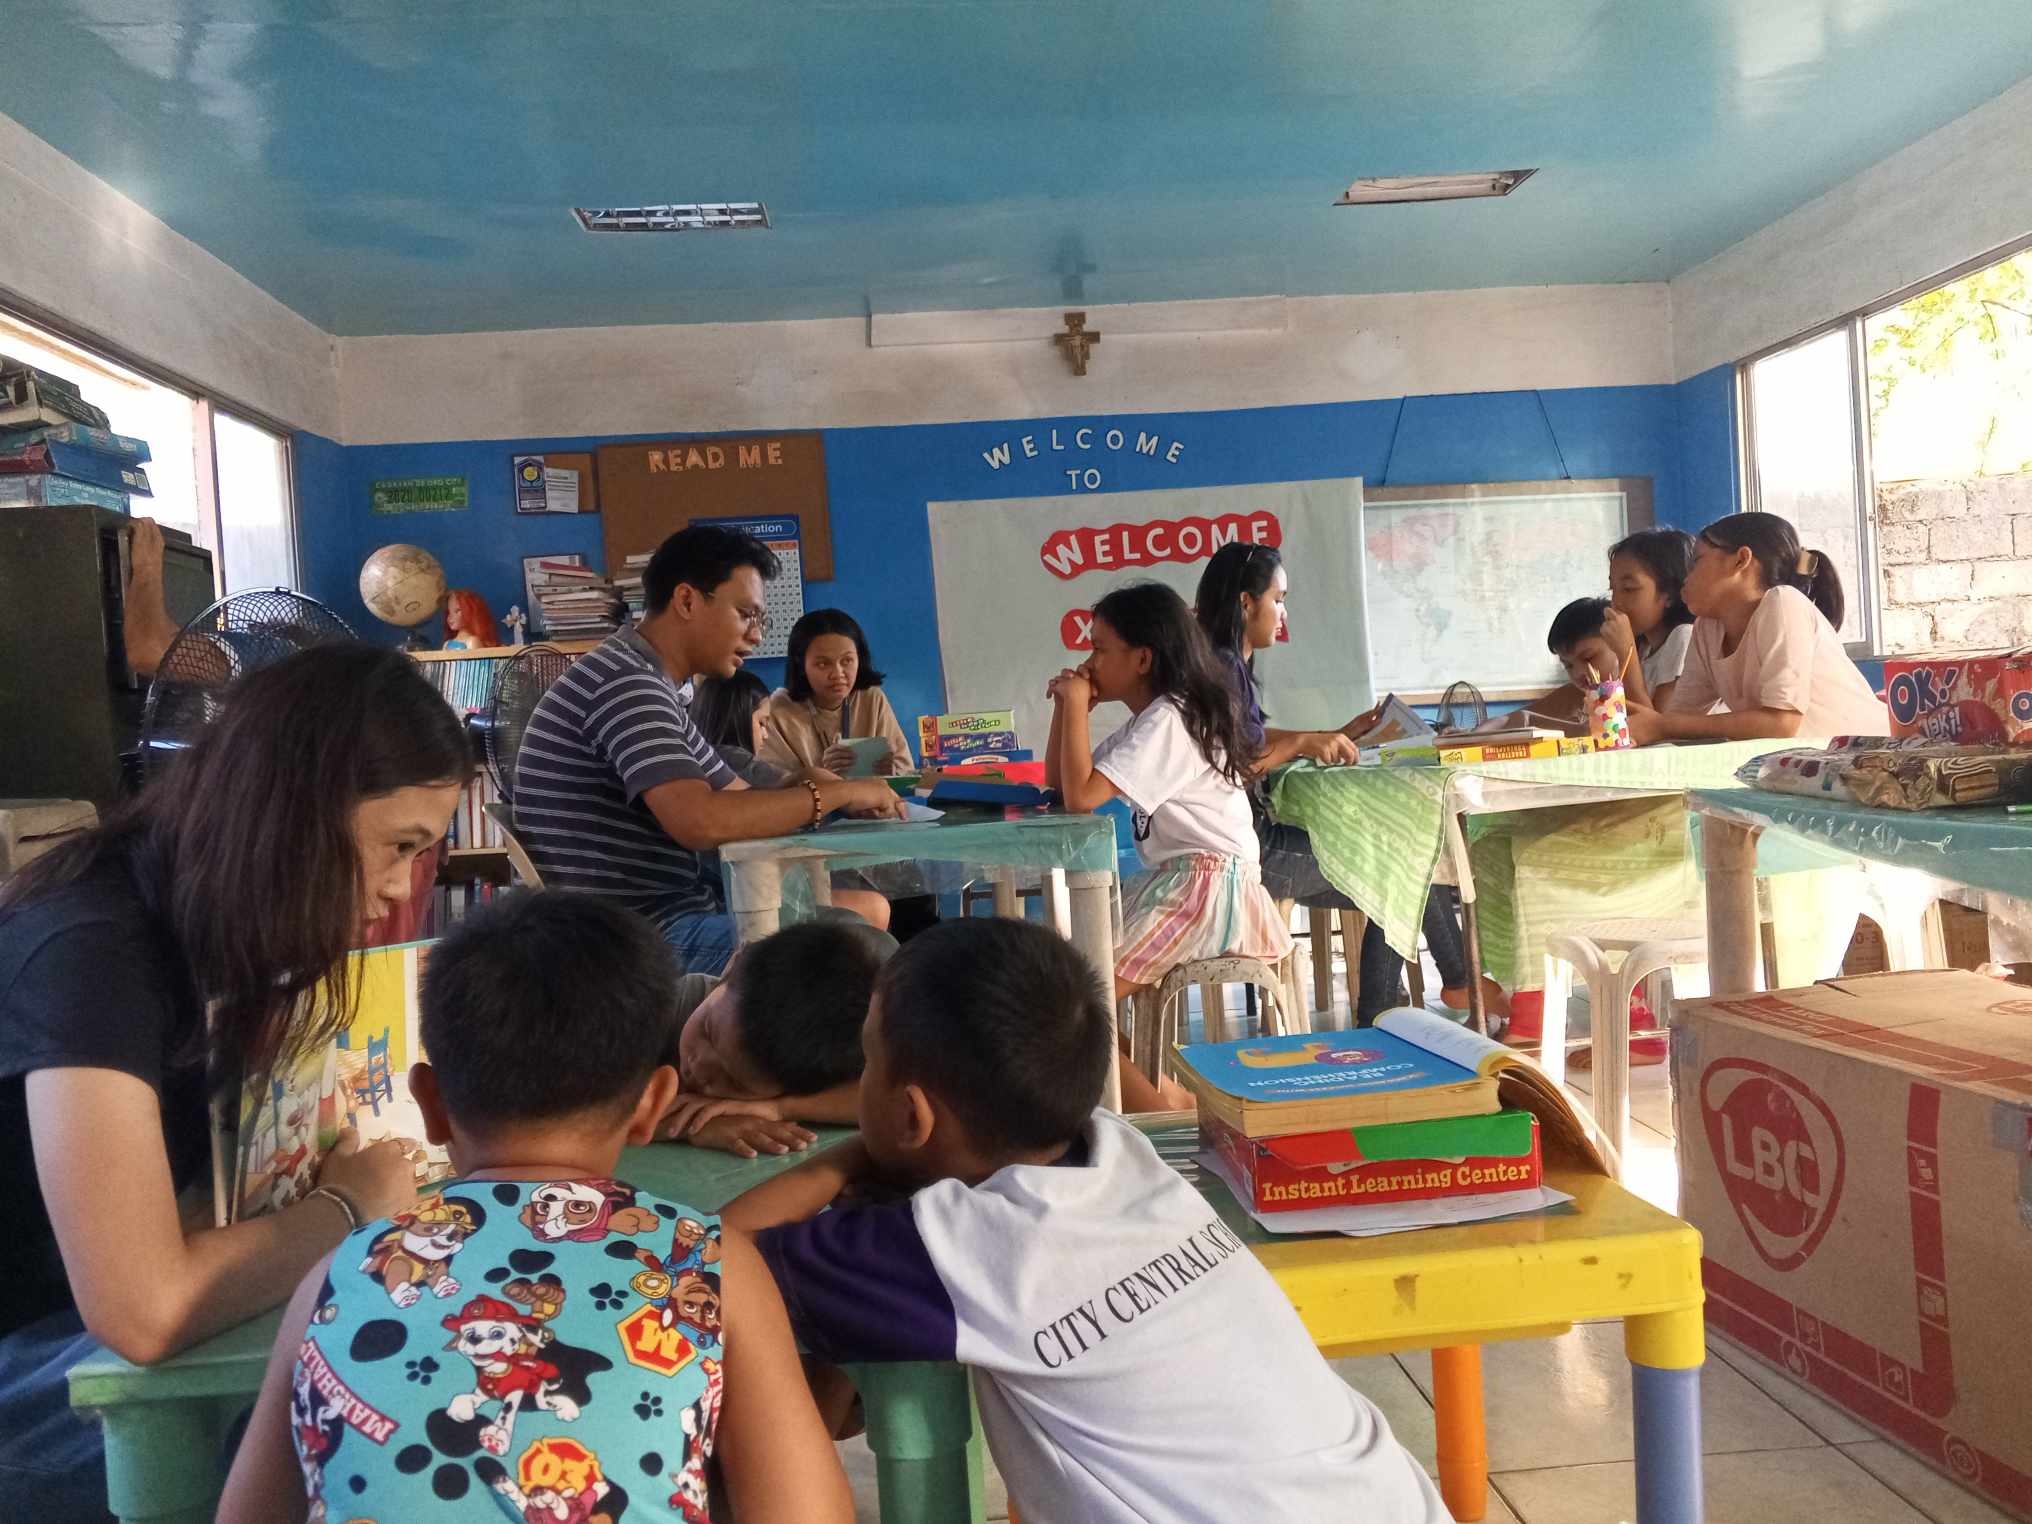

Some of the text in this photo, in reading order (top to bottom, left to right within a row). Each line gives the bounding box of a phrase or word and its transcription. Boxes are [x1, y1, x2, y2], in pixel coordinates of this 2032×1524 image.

[648, 442, 784, 473] READ ME
[981, 428, 1185, 471] WELCOME
[1066, 468, 1101, 490] TO
[1043, 520, 1268, 576] WELCOME
[1887, 666, 1959, 726] OK!
[1247, 1063, 1415, 1088] COMPREHENSION
[1293, 1072, 1386, 1087] READING
[1721, 1112, 1820, 1209] LBC
[1262, 1162, 1532, 1201] Instant Learning Center
[1033, 1299, 1108, 1369] CITY
[1104, 1236, 1220, 1324] CENTRAL
